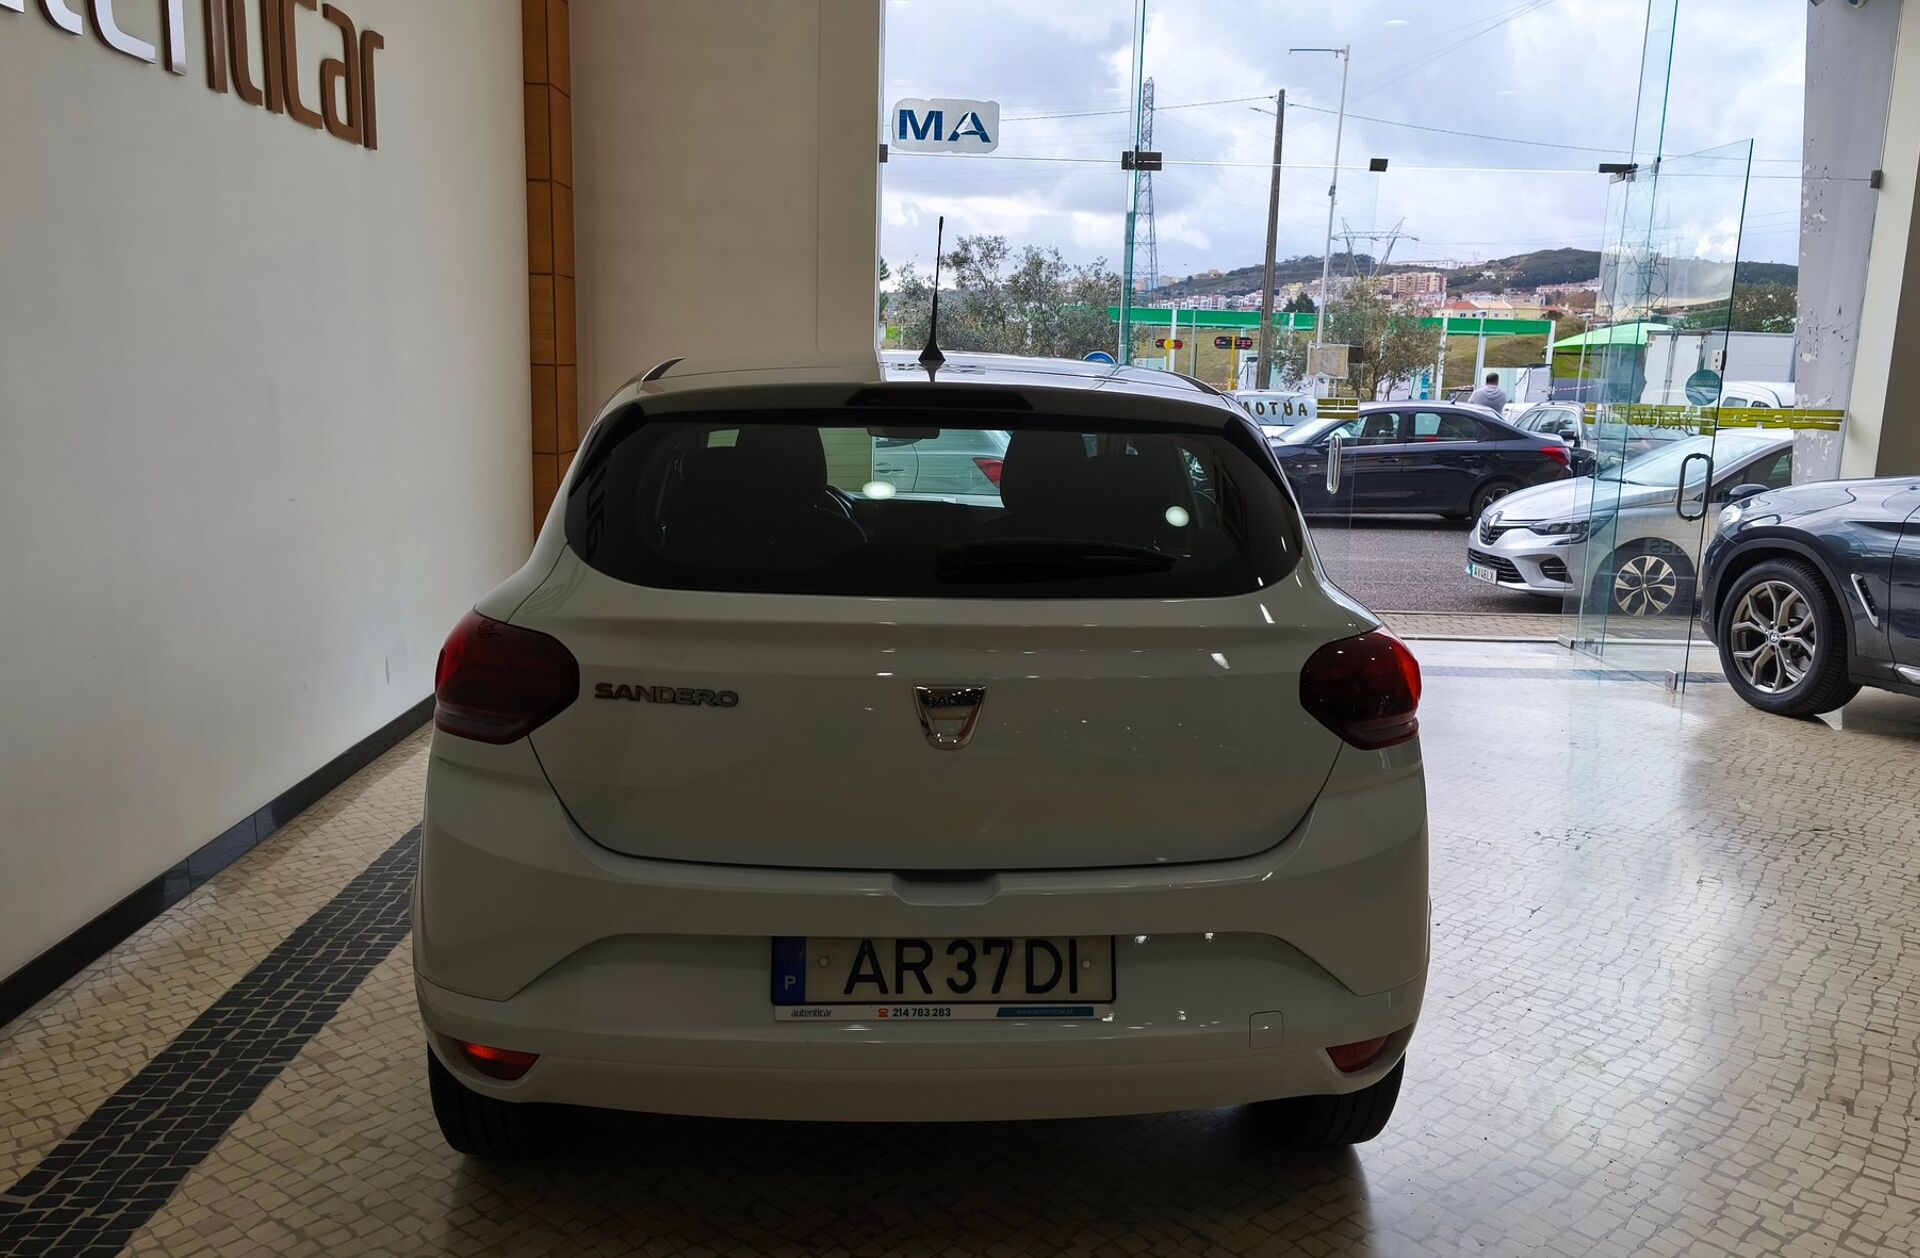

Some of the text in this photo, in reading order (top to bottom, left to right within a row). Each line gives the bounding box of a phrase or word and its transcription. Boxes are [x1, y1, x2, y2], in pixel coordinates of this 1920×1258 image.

[594, 682, 740, 708] SANDERO
[784, 976, 796, 991] P
[790, 1008, 832, 1018] autenticar
[892, 1008, 951, 1017] 214 783 283
